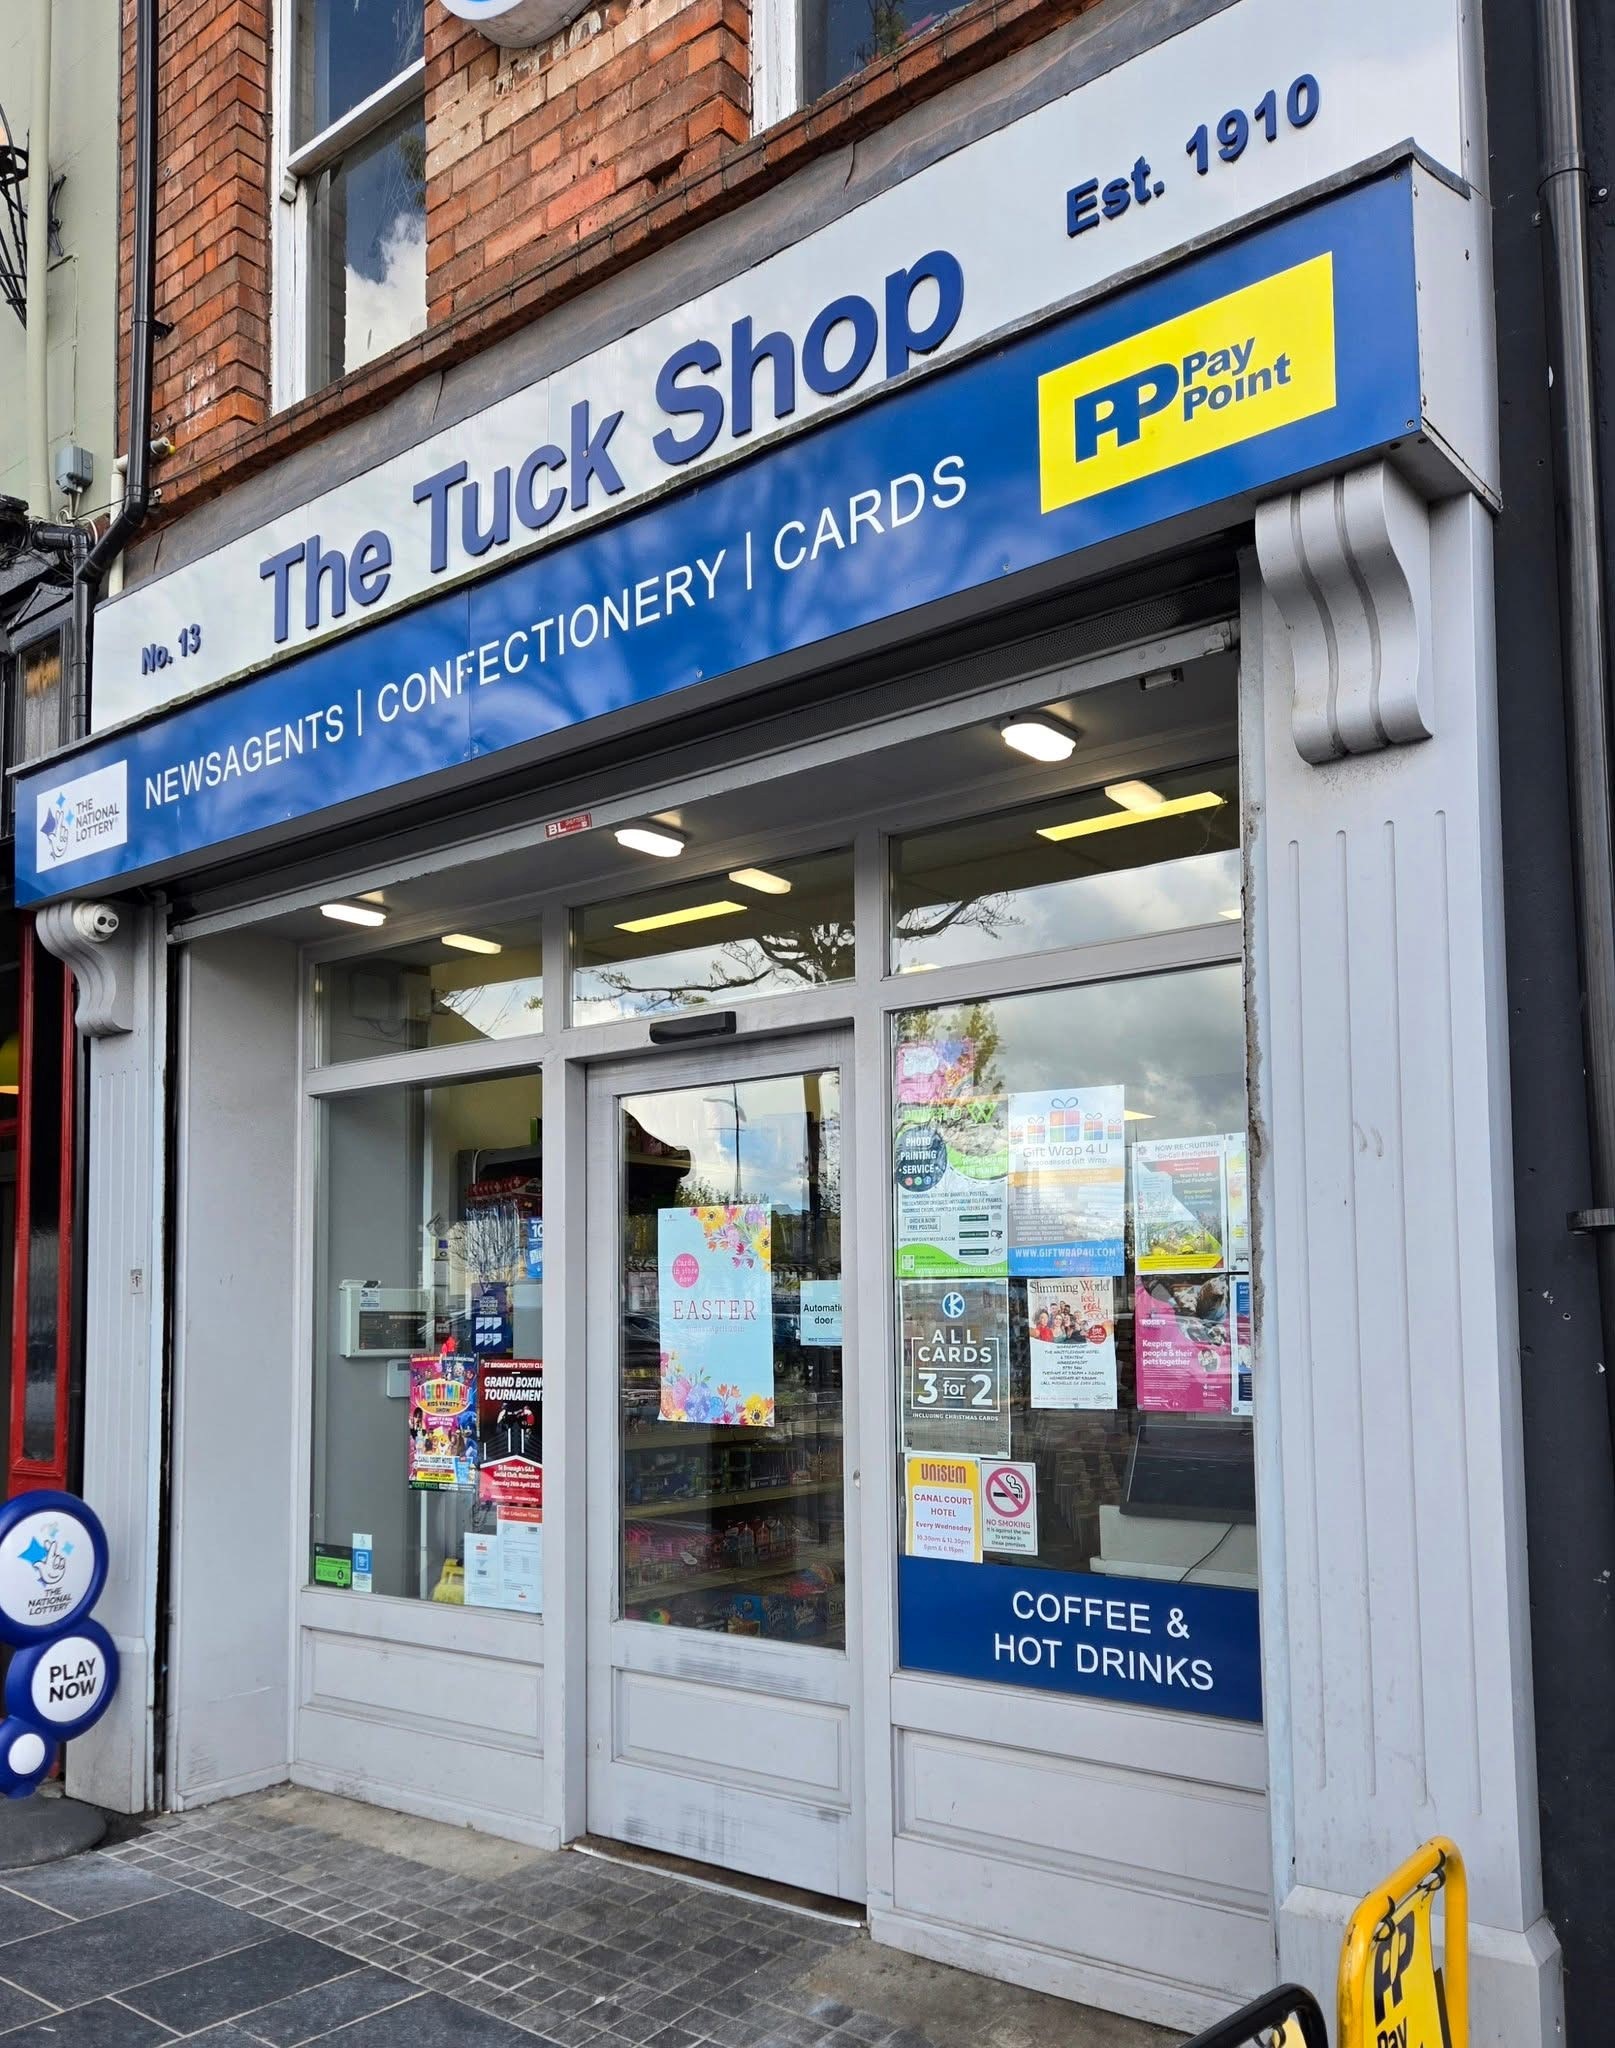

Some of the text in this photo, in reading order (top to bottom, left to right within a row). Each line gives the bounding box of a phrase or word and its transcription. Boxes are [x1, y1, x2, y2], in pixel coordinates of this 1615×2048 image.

[1066, 73, 1320, 238] Est. 1910
[1183, 337, 1256, 387] Pay
[1183, 352, 1292, 422] Point
[260, 249, 964, 643] The Tuck Shop
[144, 704, 345, 810] NEWSAGENTS
[377, 550, 727, 723] CONFECTIONERY
[773, 455, 968, 571] CARDS
[141, 622, 201, 675] No. 13
[76, 798, 93, 814] THE
[76, 802, 120, 829] NATIONAL
[76, 819, 115, 842] LOTTERY
[905, 1136, 932, 1147] PHOTO
[1155, 1141, 1219, 1152] NOW RECRUITING
[900, 1150, 937, 1160] PRINTING
[1023, 1143, 1108, 1160] Gift Wrap 4 U
[902, 1164, 935, 1175] SERVICE
[1015, 1247, 1116, 1258] WWW.GIFTWRAP4U.COM
[1030, 1280, 1111, 1295] Slimming World
[673, 1299, 756, 1320] EASTER
[814, 1316, 833, 1324] door
[932, 1329, 977, 1344] ALL
[1142, 1340, 1172, 1349] Keeping
[917, 1346, 992, 1363] CARDS
[1142, 1350, 1168, 1359] people
[1142, 1358, 1191, 1367] pets together
[484, 1376, 543, 1388] GRAND BOXIN
[917, 1373, 993, 1406] 3 for 2
[945, 1413, 978, 1421] CHRISTMAS
[914, 1493, 972, 1505] CANAL COURT
[930, 1508, 956, 1517] HOTEL
[916, 1521, 972, 1533] Every Wednesday
[986, 1518, 1031, 1529] NO SMOKING
[44, 1587, 62, 1597] THE
[28, 1593, 72, 1608] NATIONAL
[29, 1601, 70, 1616] LOTTERY
[1012, 1590, 1190, 1640] COFFEE &
[994, 1632, 1214, 1692] HOT DRINKS
[50, 1657, 96, 1683] PLAY
[49, 1677, 96, 1703] NOW
